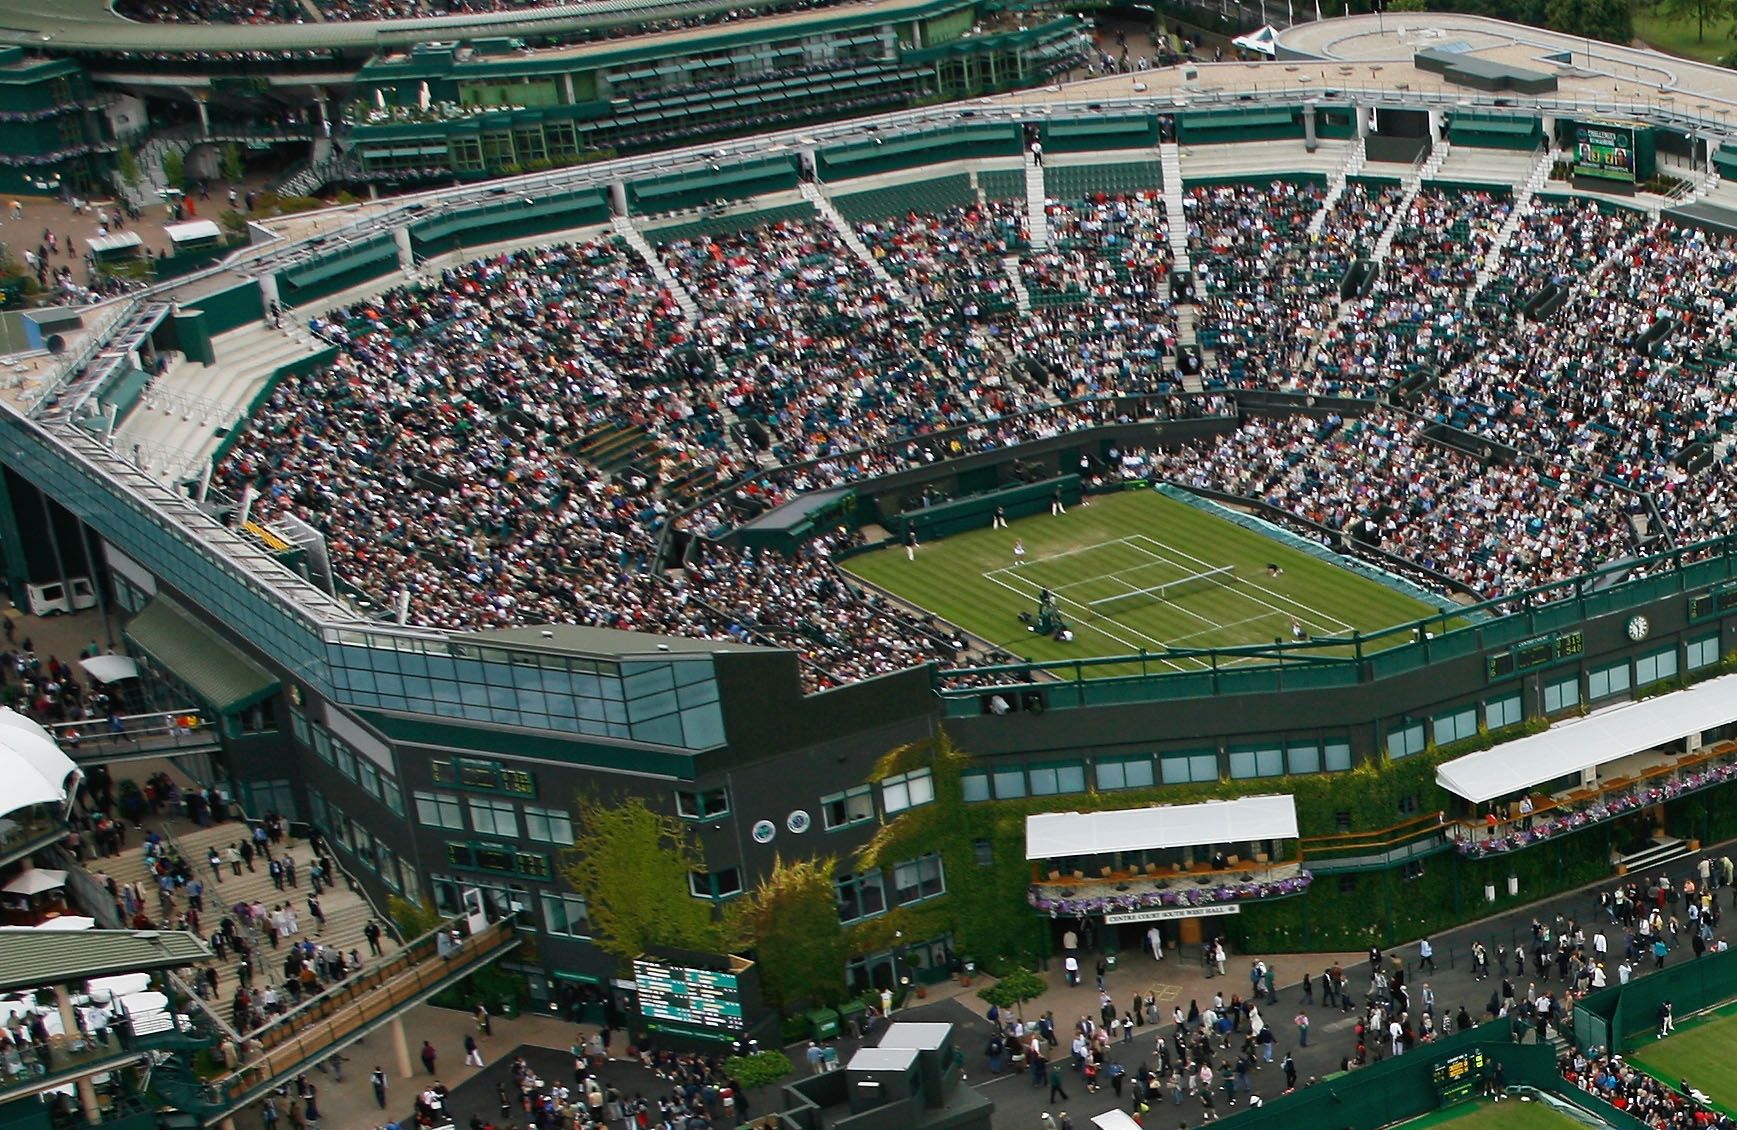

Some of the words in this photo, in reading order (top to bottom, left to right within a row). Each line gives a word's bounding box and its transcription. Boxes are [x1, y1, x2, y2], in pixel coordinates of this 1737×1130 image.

[1109, 914, 1136, 923] CENTRE
[1138, 913, 1160, 921] COURT
[1162, 911, 1184, 919] SOUTH
[1185, 908, 1204, 917] WEST
[1205, 906, 1224, 914] HALL
